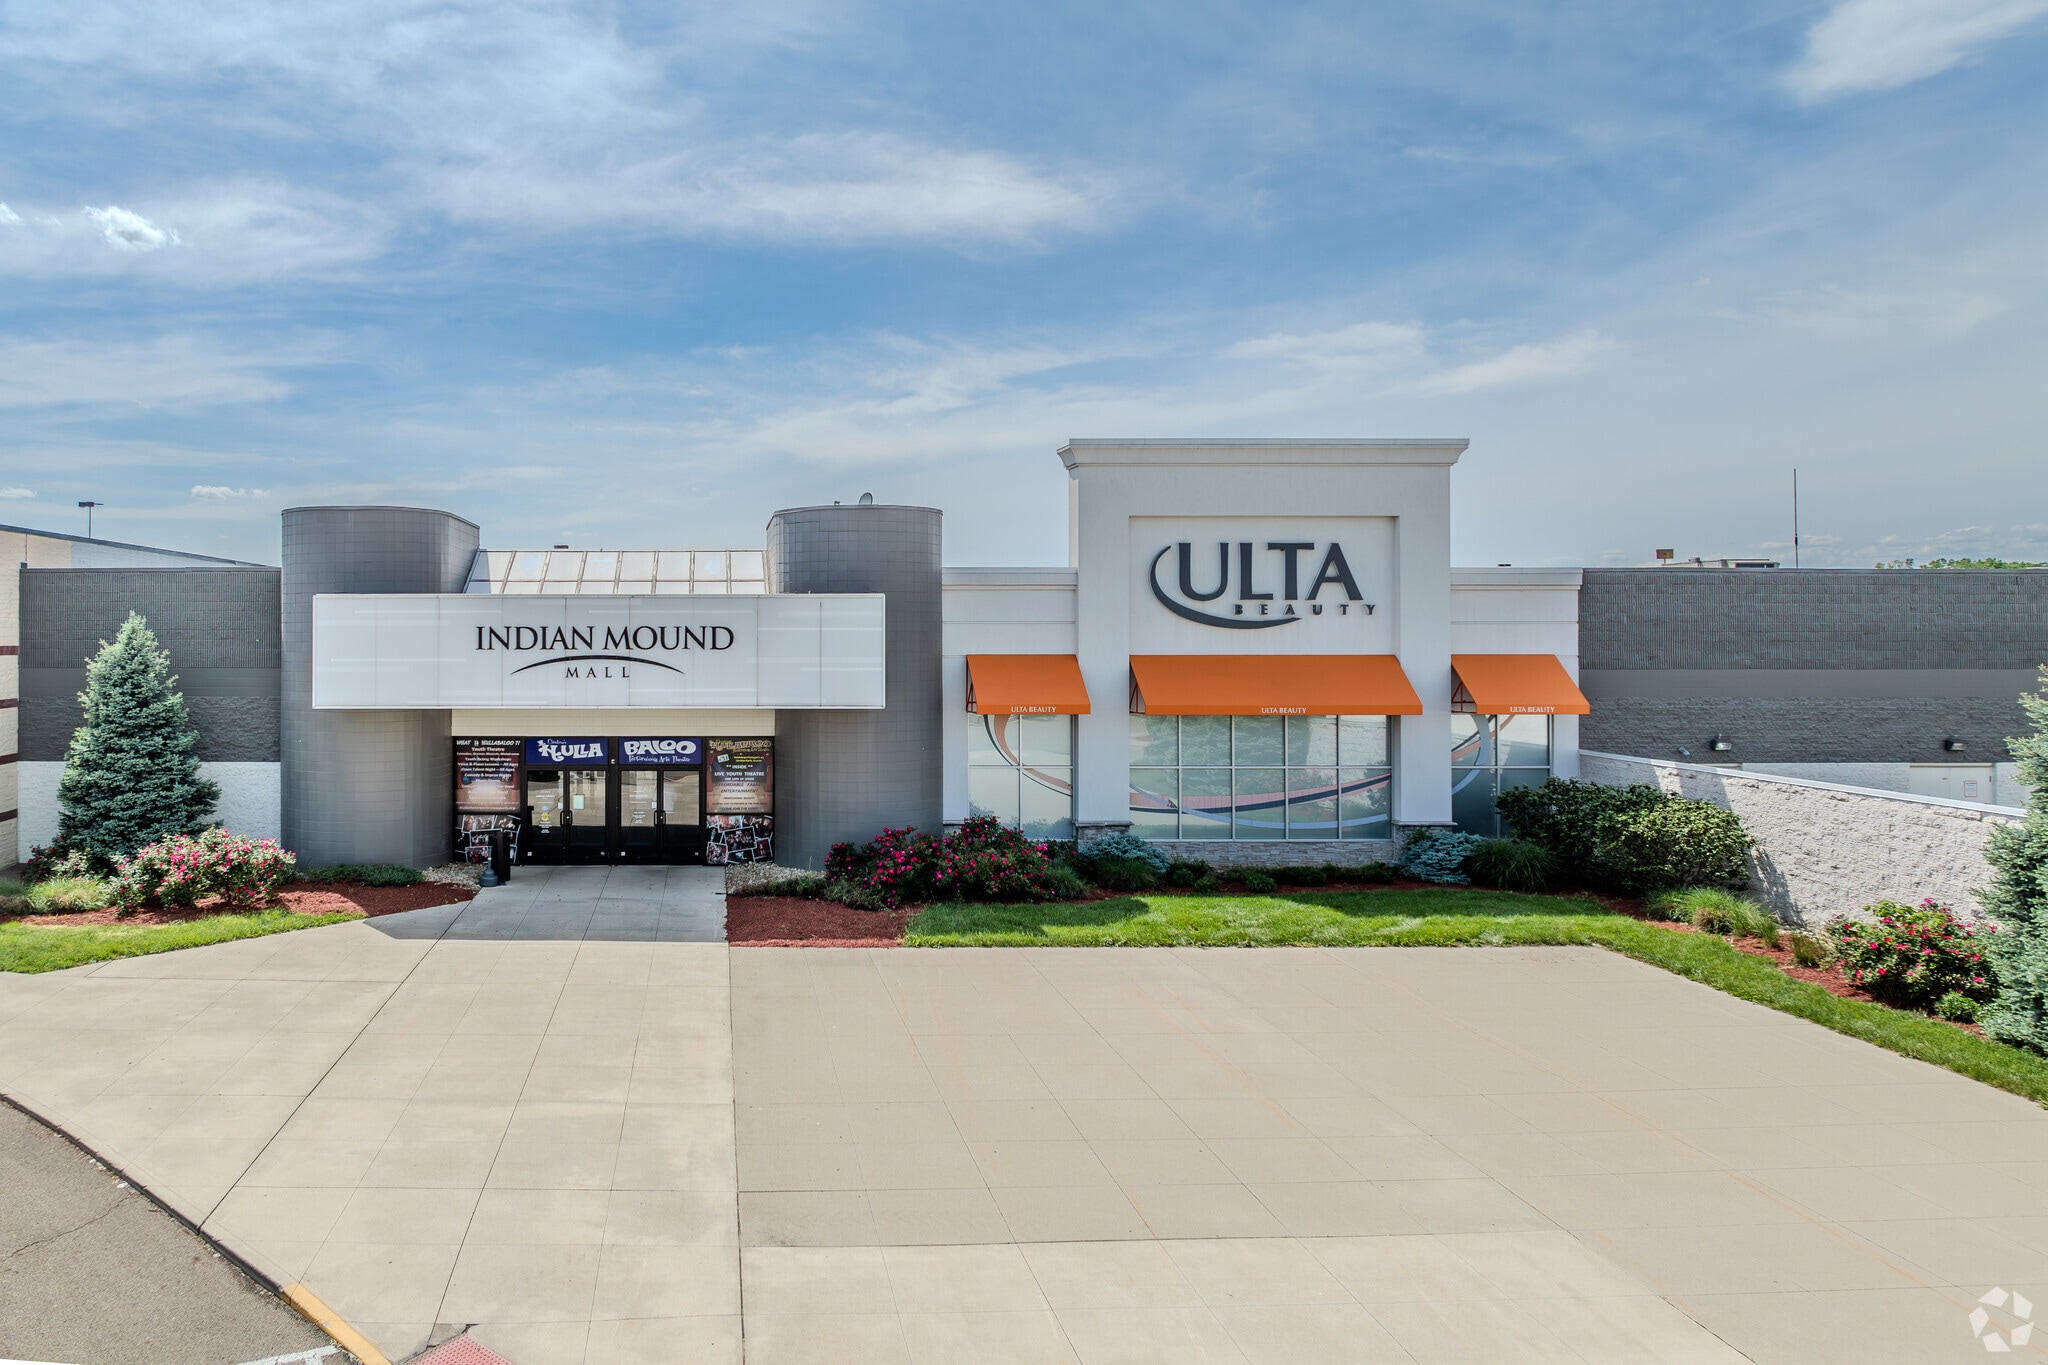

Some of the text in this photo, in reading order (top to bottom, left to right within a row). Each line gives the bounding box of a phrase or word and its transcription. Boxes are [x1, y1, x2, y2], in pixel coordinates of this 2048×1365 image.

[1177, 542, 1364, 601] ULTA
[1233, 604, 1377, 616] BEAUTY
[475, 625, 735, 651] INDIAN MOUND
[565, 666, 630, 678] MALL
[537, 740, 604, 762] HULLA
[623, 740, 697, 755] BALOO
